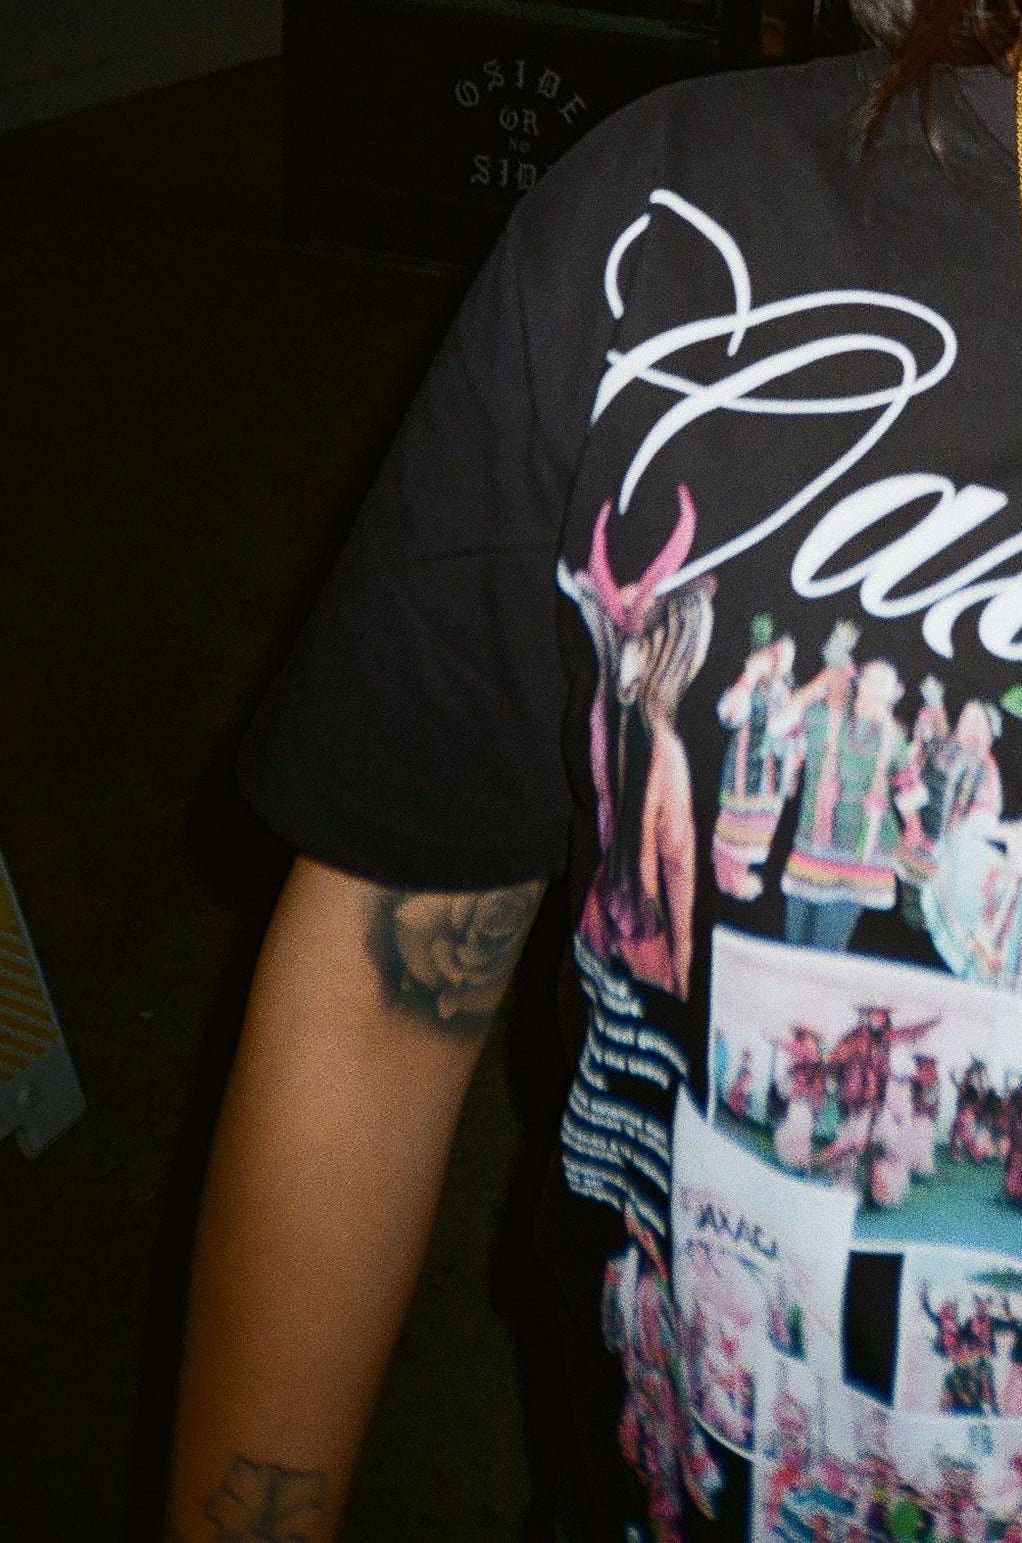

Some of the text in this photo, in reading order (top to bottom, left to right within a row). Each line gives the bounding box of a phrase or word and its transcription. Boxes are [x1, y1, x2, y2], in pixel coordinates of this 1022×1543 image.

[454, 56, 588, 125] OSIDE
[499, 105, 541, 137] OR
[468, 153, 538, 194] SID
